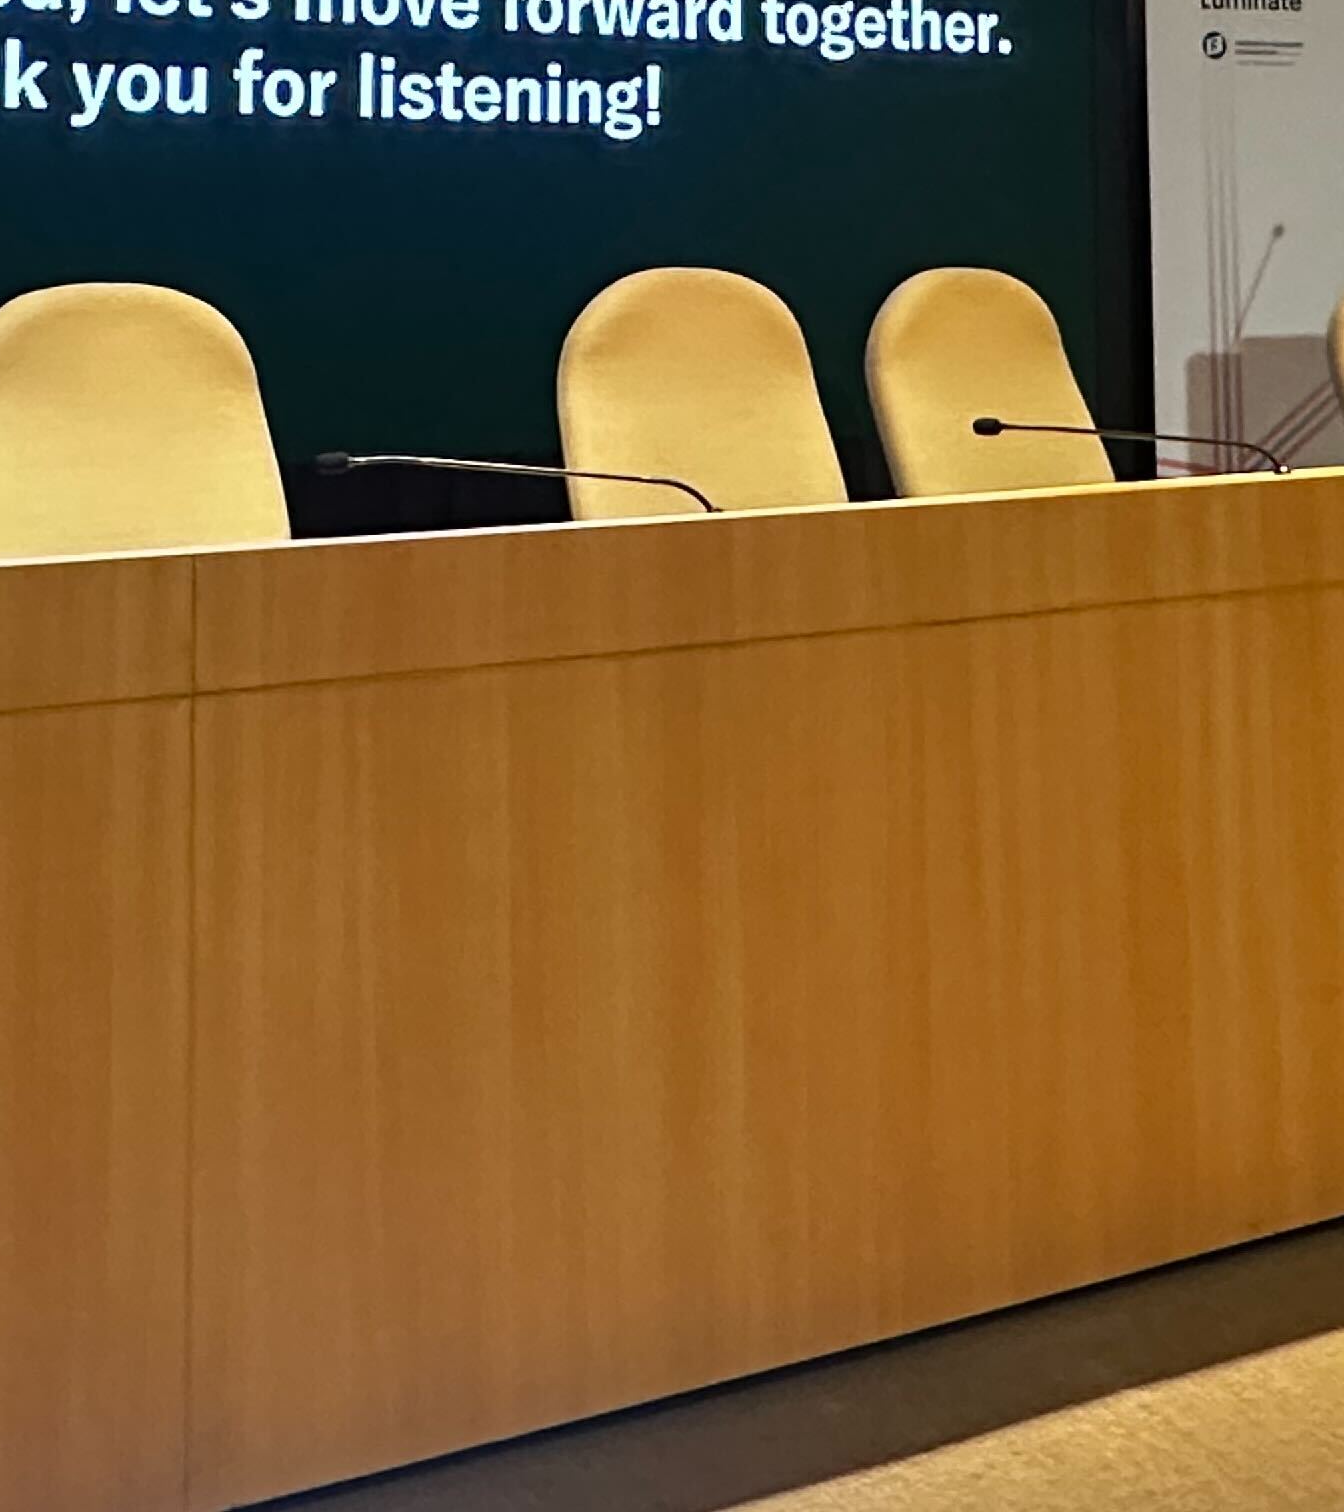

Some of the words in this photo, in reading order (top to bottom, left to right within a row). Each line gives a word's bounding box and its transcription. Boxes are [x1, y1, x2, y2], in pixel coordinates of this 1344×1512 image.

[70, 62, 208, 128] you
[232, 47, 338, 118] for
[359, 52, 661, 140] listening!
